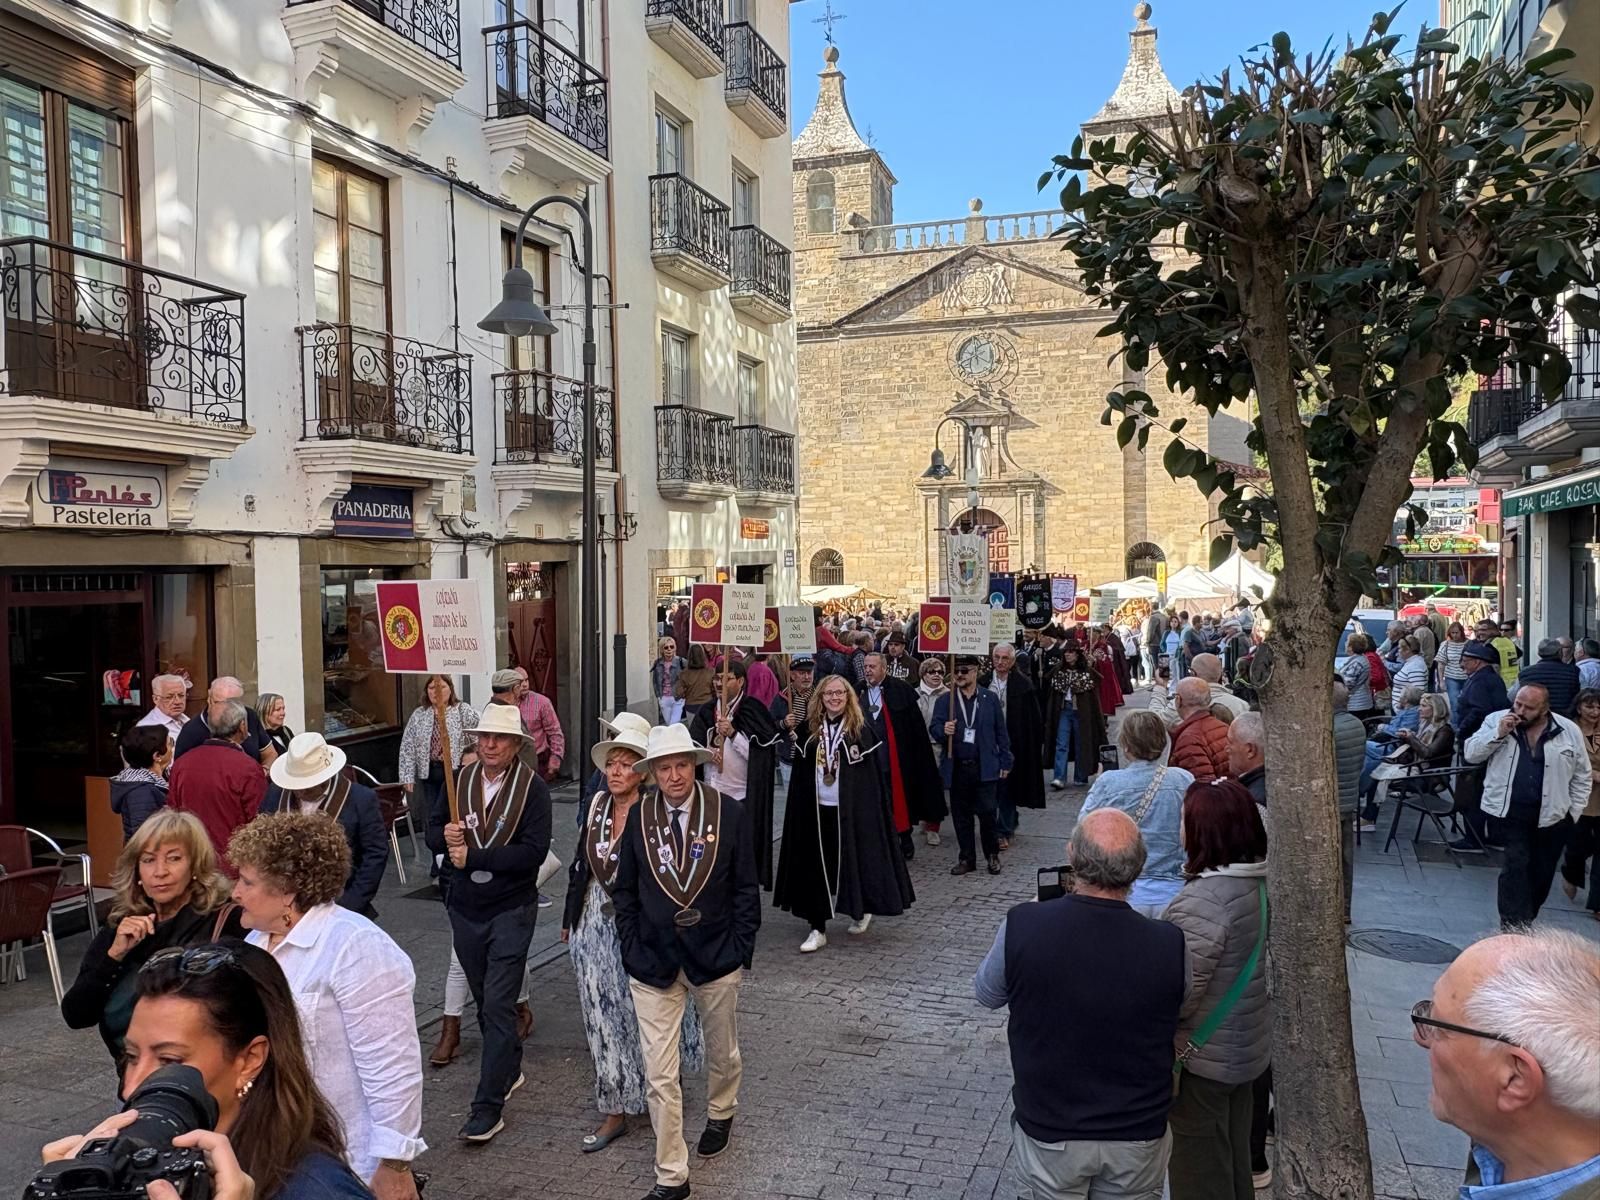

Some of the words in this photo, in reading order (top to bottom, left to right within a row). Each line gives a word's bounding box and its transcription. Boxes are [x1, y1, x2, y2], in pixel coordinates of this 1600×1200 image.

[337, 501, 411, 520] PANADERIA
[1518, 496, 1534, 512] BAR
[1540, 490, 1562, 508] CAFE
[53, 506, 151, 526] Pastelería
